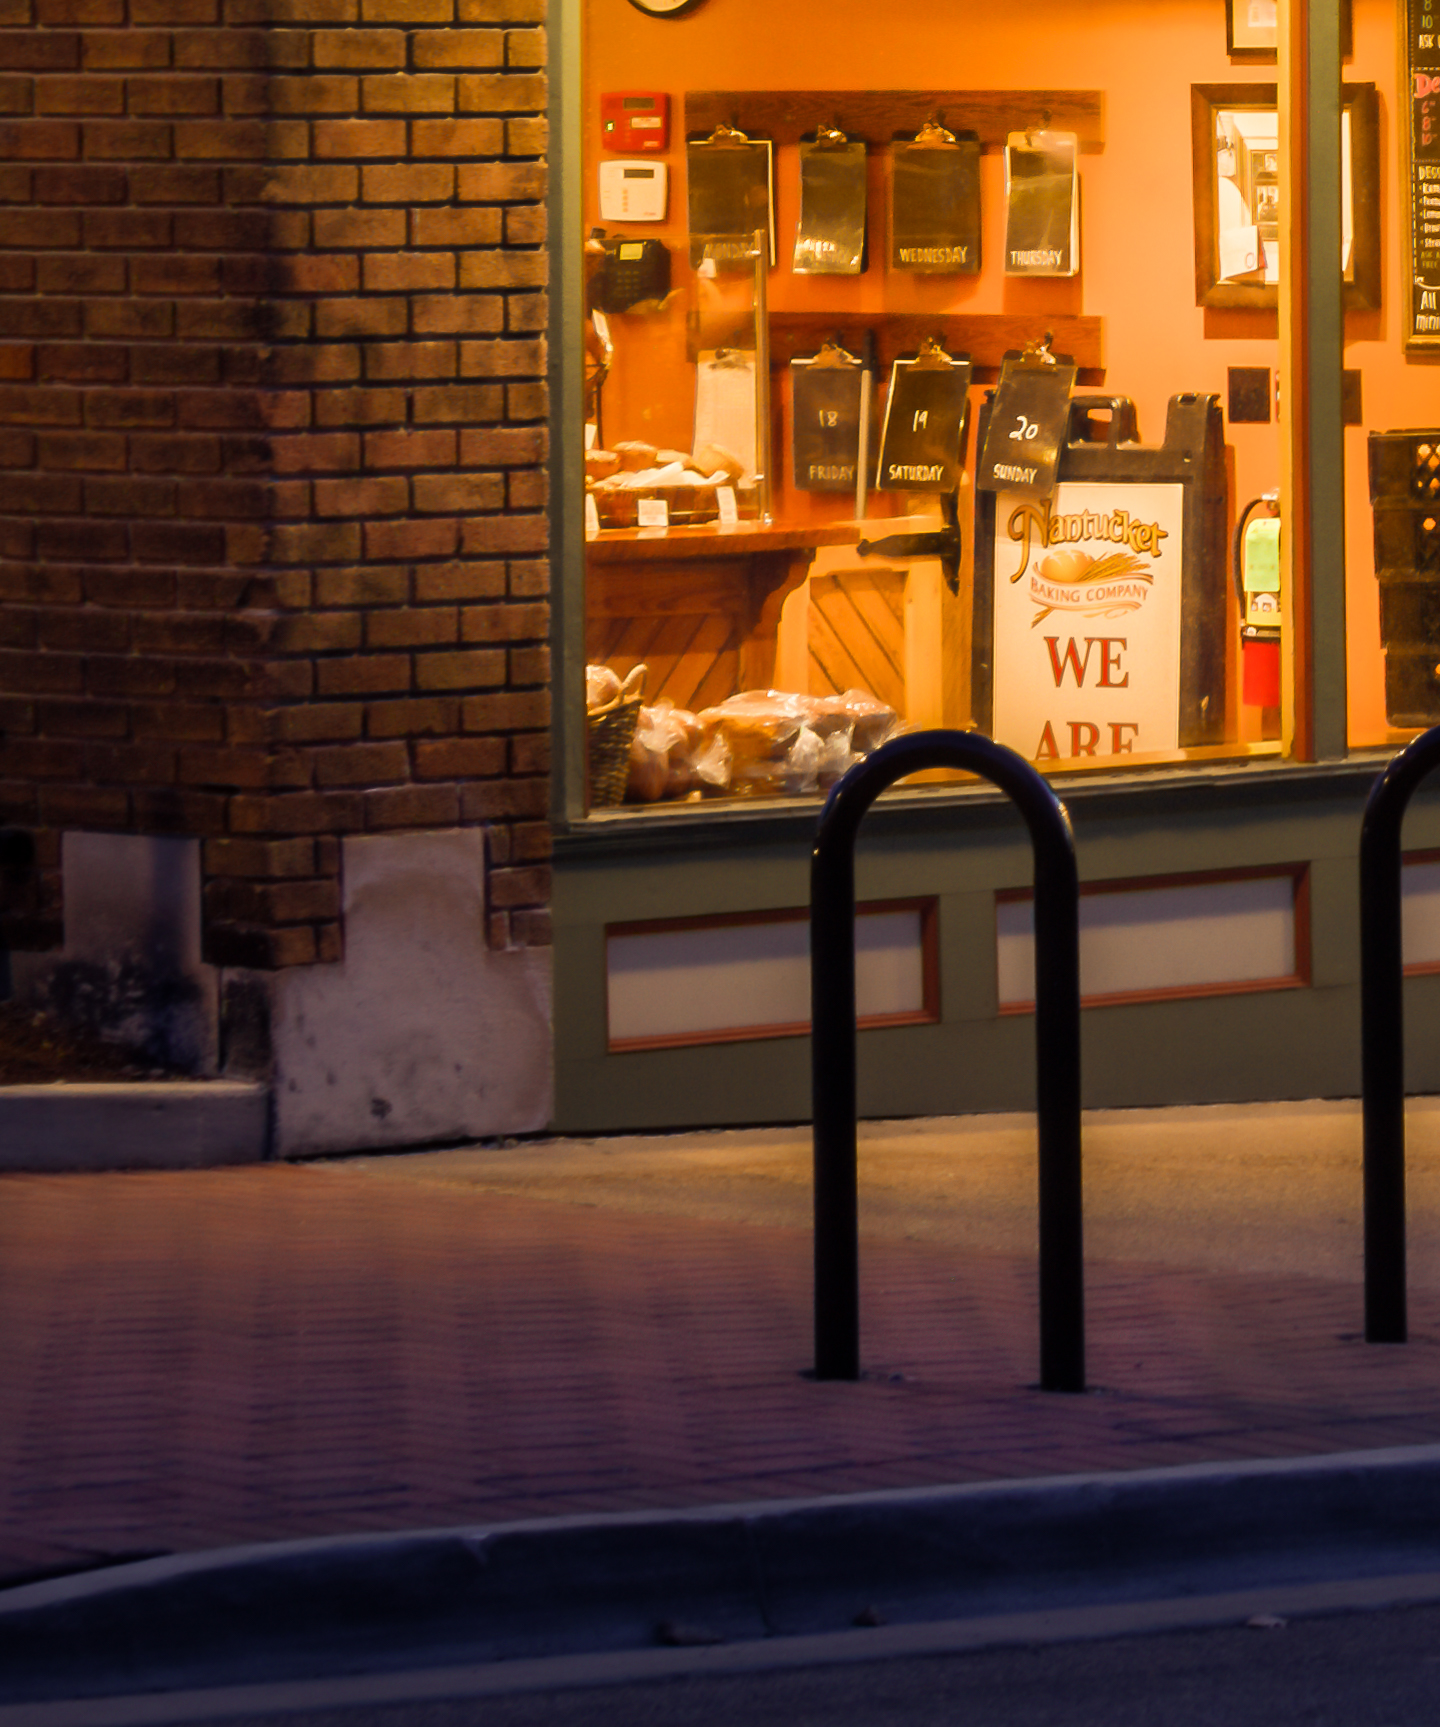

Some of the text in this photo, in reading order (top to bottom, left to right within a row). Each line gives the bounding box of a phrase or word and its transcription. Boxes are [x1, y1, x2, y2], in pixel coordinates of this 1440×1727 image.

[900, 245, 968, 264] WEDNESDAY
[1010, 249, 1062, 266] THURSDAY
[818, 410, 838, 427] 18
[912, 410, 928, 432] 19
[1009, 415, 1039, 441] 20
[809, 464, 855, 480] FRIDAY
[889, 464, 944, 481] SATURDAY
[993, 464, 1038, 484] SUNDAY
[1007, 499, 1168, 583] Nantucket
[1030, 575, 1149, 603] BAKING COMPANY
[1044, 636, 1129, 688] WE
